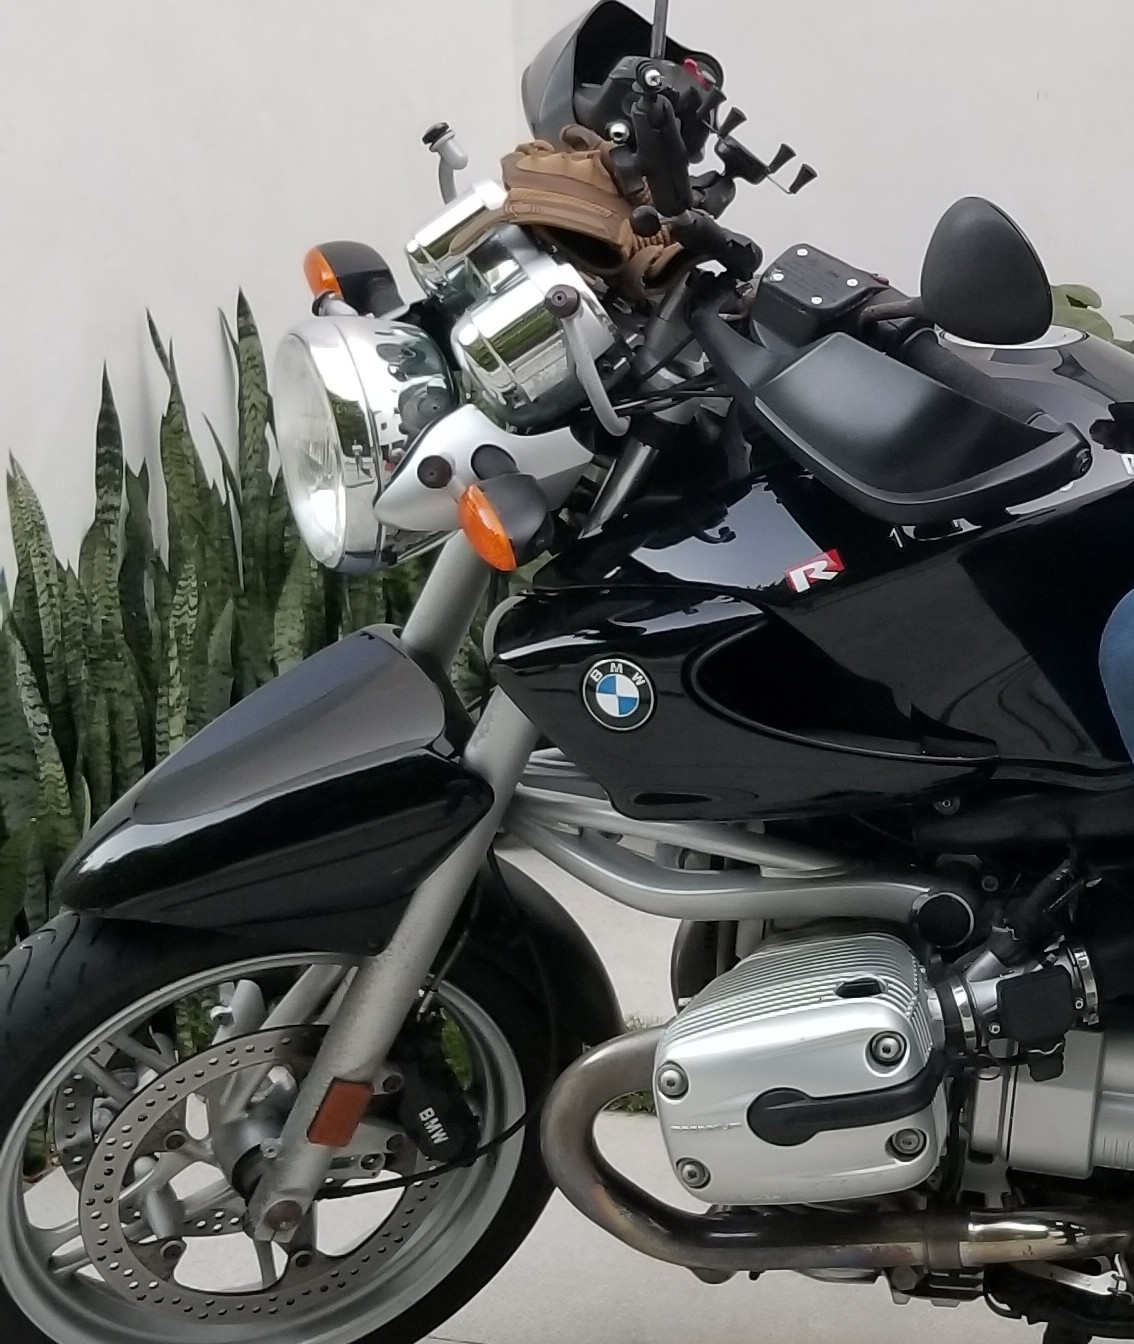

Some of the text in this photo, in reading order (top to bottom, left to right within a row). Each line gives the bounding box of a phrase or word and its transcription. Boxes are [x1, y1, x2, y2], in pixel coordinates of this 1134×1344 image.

[789, 560, 839, 593] R
[589, 662, 646, 687] BMW
[418, 1106, 449, 1144] BMW
